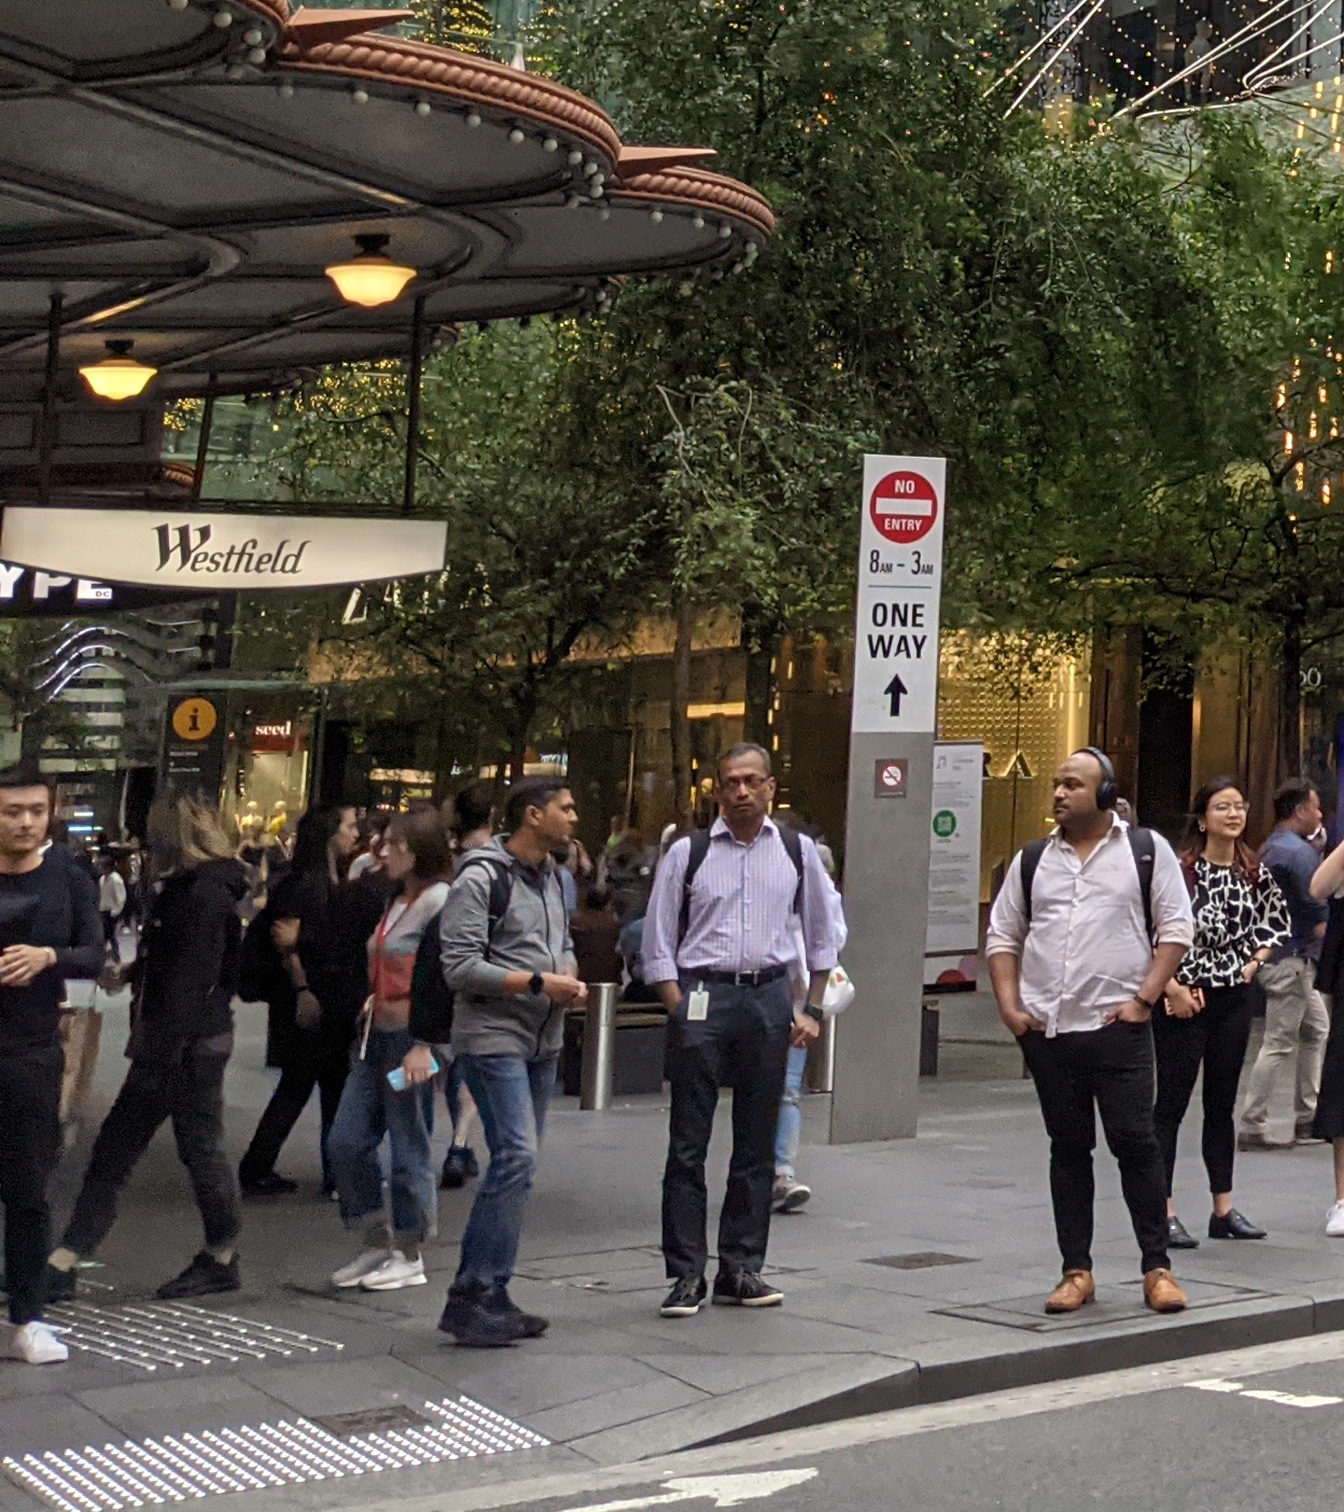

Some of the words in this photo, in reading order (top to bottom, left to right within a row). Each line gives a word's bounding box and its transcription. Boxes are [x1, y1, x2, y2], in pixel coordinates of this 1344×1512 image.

[894, 479, 915, 494] NO
[884, 517, 923, 532] ENTRY
[151, 522, 312, 574] Westfield
[872, 602, 925, 629] ONE
[867, 634, 928, 659] WAY
